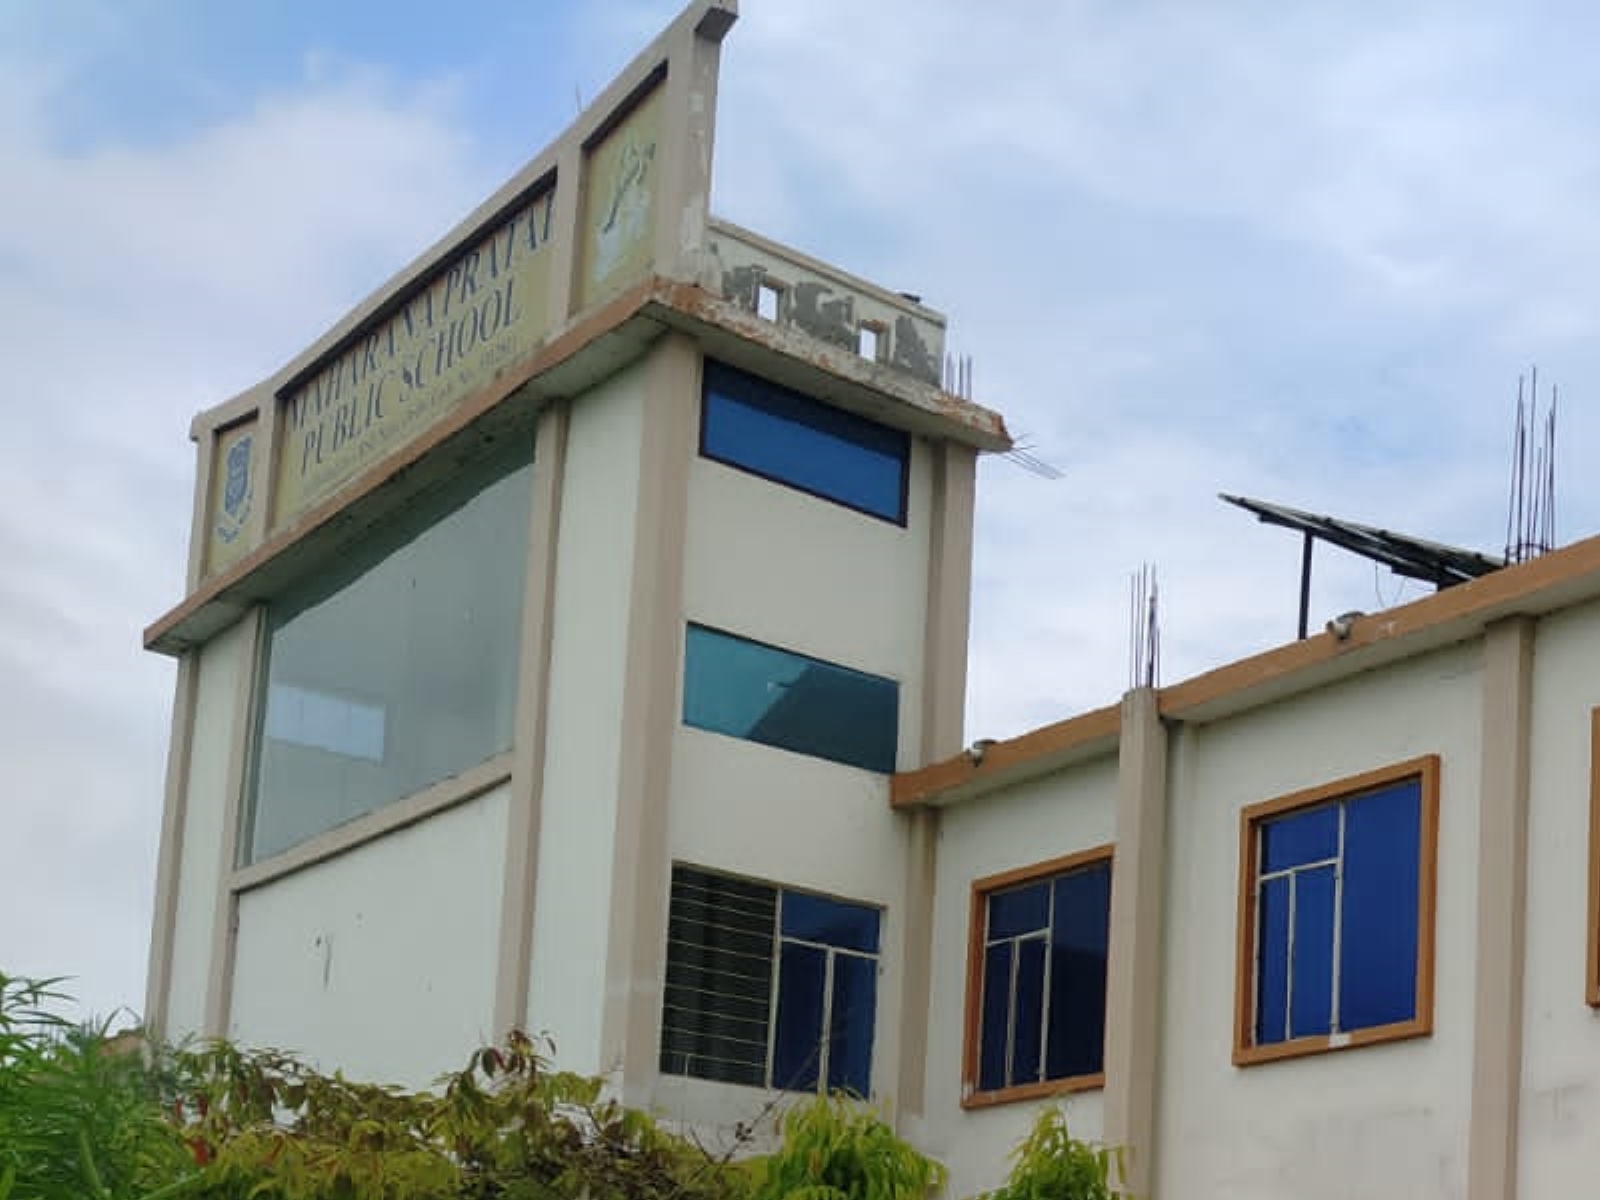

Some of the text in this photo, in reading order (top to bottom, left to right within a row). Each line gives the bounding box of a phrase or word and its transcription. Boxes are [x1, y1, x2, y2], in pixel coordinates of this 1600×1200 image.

[290, 288, 435, 430] MAHARANA
[301, 370, 386, 476] PUBLIC
[400, 274, 524, 402] SCHOOL
